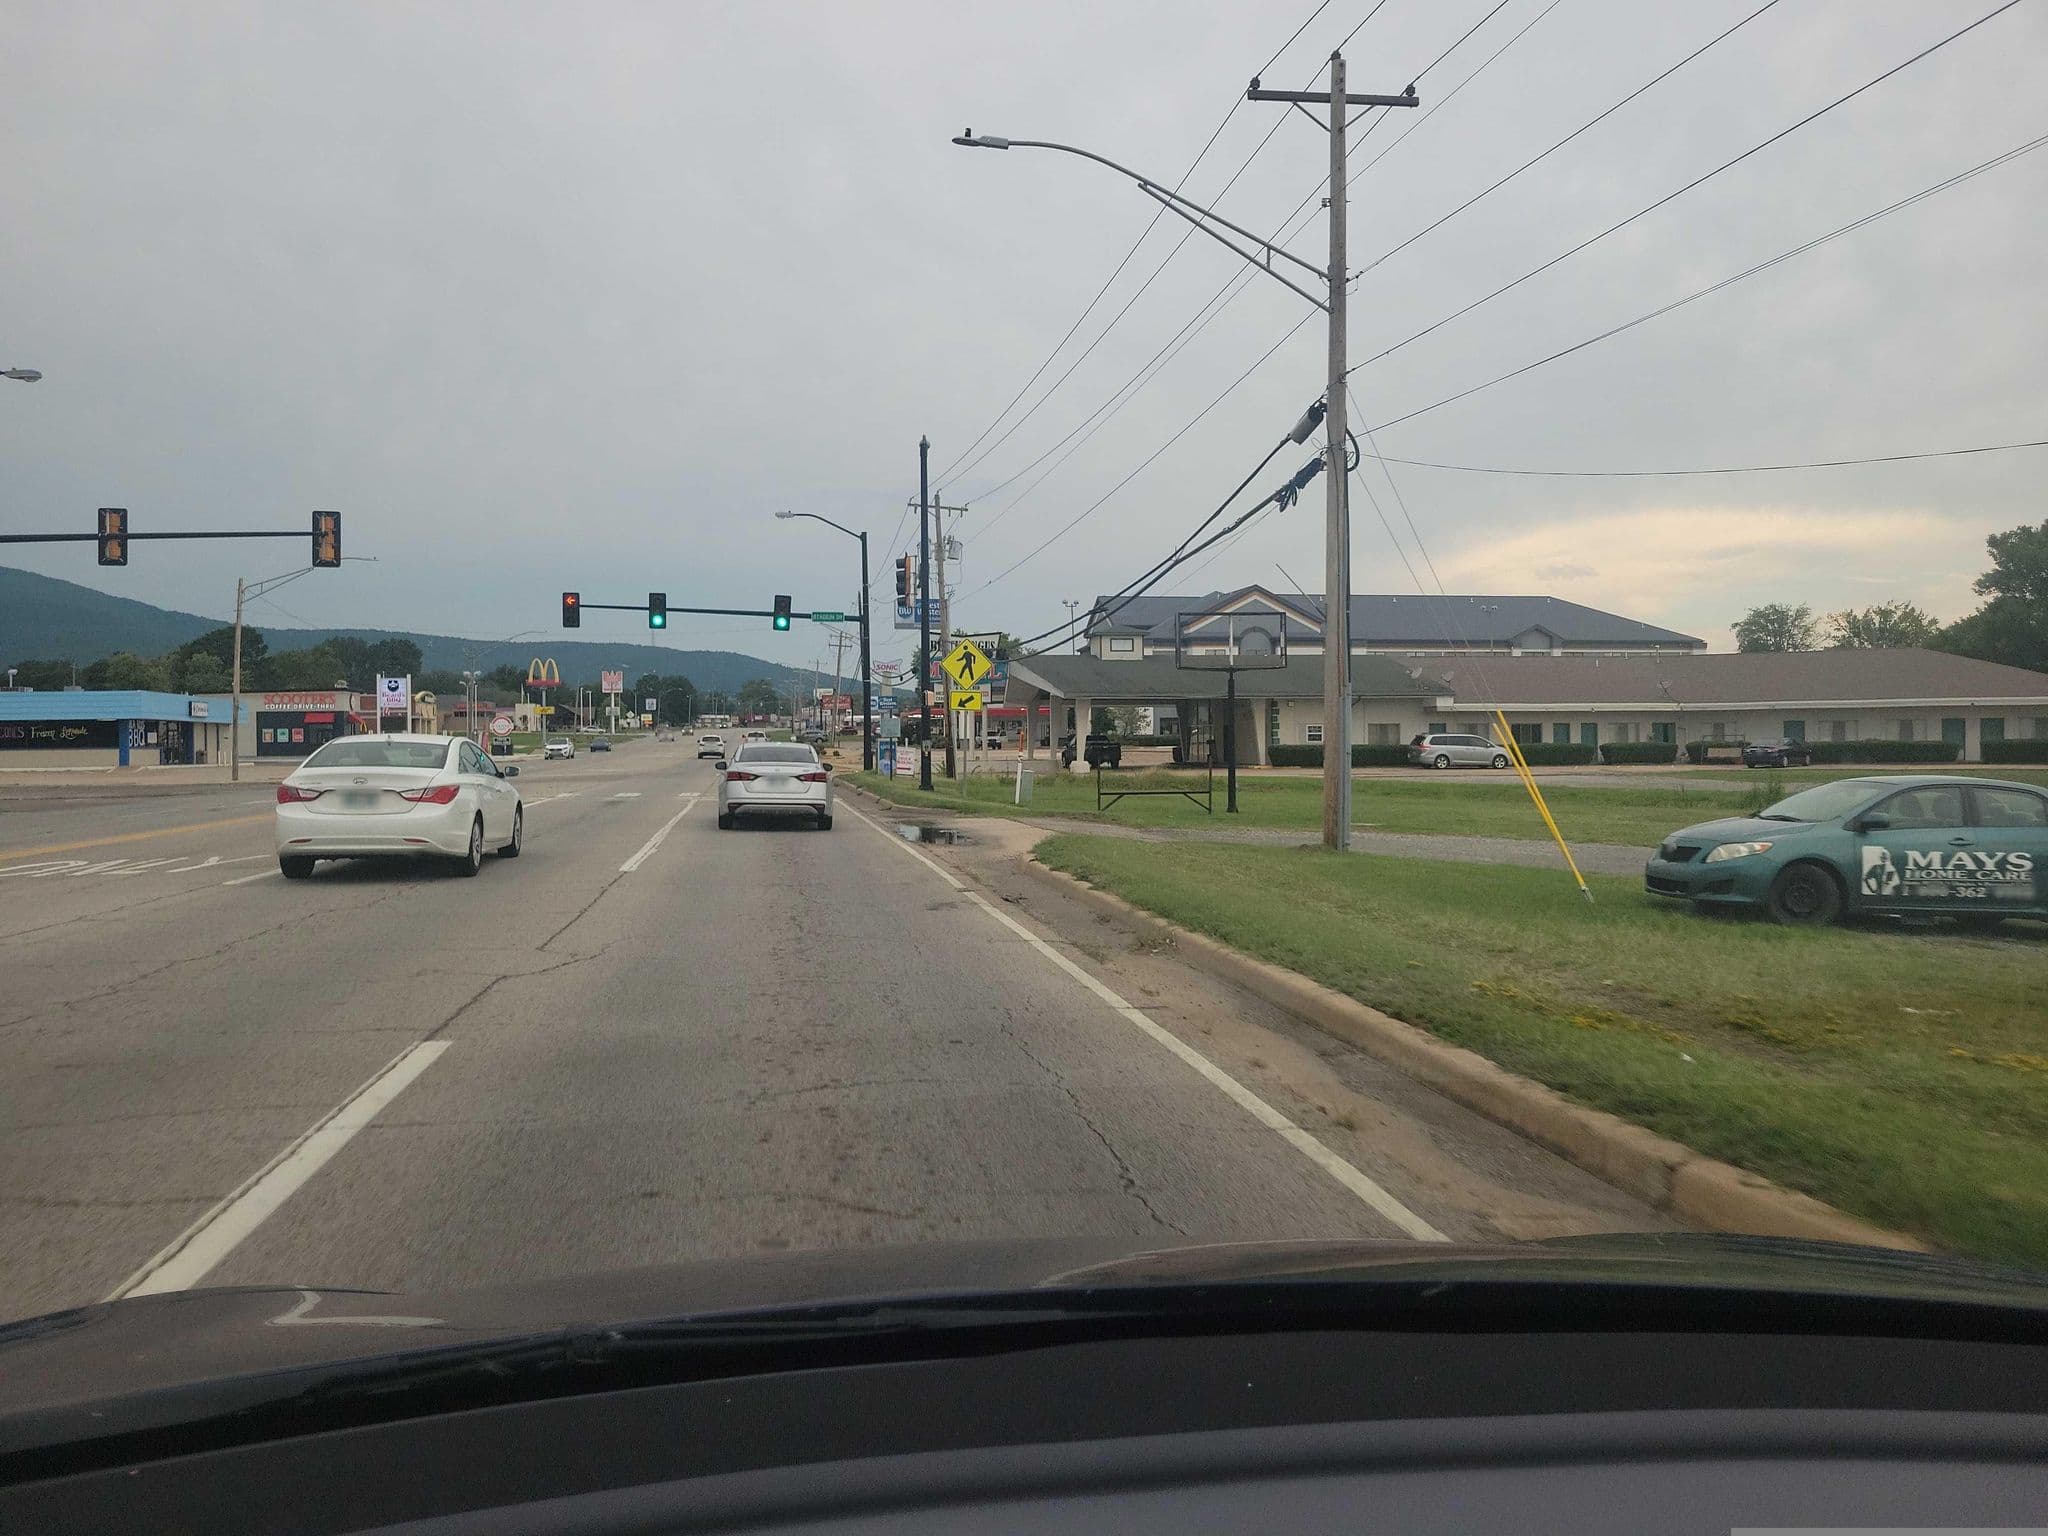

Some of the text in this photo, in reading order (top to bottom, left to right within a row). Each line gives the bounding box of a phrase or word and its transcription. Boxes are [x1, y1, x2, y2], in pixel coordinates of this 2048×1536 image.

[128, 729, 146, 747] BBQ
[1904, 851, 2034, 871] MAYS
[1904, 870, 2032, 880] HOME CARE
